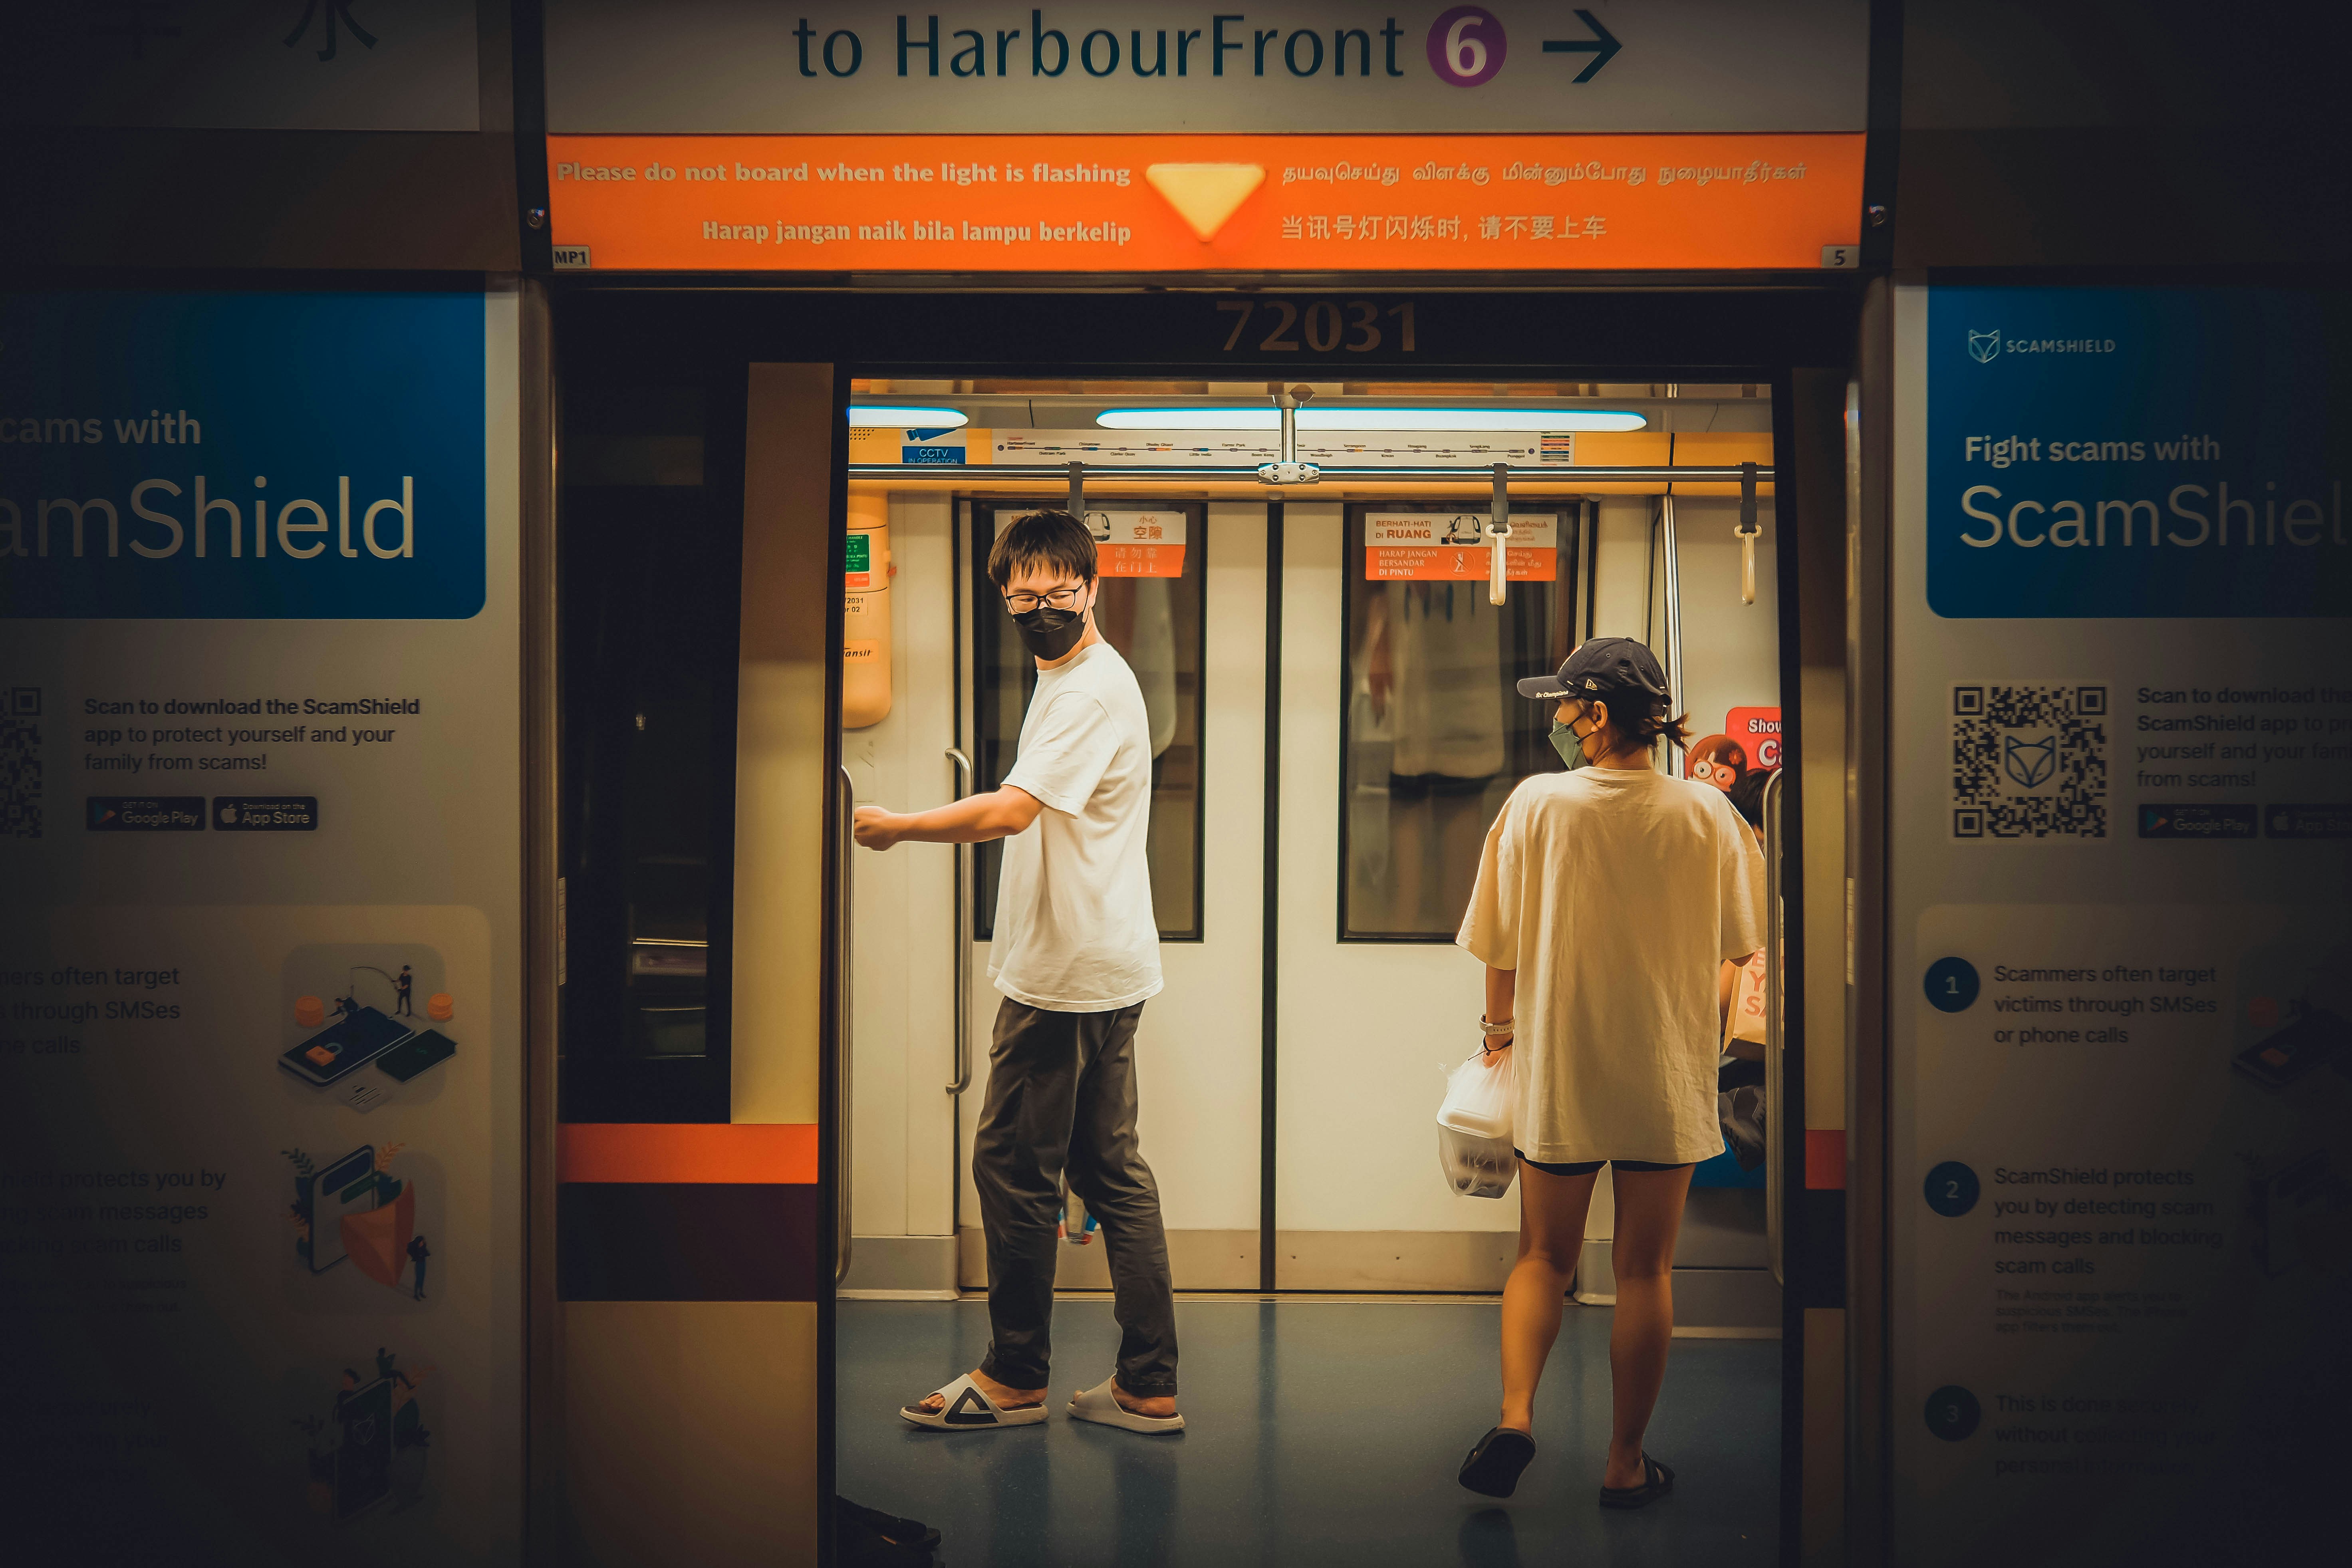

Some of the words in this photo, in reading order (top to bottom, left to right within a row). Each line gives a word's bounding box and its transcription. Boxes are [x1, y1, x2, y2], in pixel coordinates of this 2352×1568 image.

[793, 18, 863, 77] to
[897, 8, 1404, 77] HarbourFront
[1445, 16, 1487, 77] 6
[556, 162, 636, 183] Please
[644, 162, 677, 182] do
[685, 163, 727, 182] not
[735, 162, 809, 183] board
[817, 162, 885, 182] when
[893, 163, 934, 182] the
[941, 162, 997, 186] light
[1006, 162, 1025, 182] is
[1033, 162, 1131, 186] flashing
[1282, 160, 1400, 186] தயவுசெய்து
[1412, 160, 1490, 186] விளக்கு
[703, 221, 769, 246] Harap
[776, 221, 851, 244] jangan
[858, 220, 907, 241] naik
[913, 220, 955, 242] bila
[963, 221, 1032, 245] lampu
[1039, 221, 1131, 246] berkelip
[554, 250, 587, 265] MP1
[1834, 250, 1844, 266] 5
[1215, 300, 1416, 353] 72031
[2007, 339, 2116, 353] SCAMSHIELD
[115, 410, 201, 444] with
[919, 449, 948, 457] CCTV
[1965, 436, 2041, 468] Fight
[2048, 441, 2146, 462] scams
[2154, 435, 2220, 461] with
[1133, 526, 1163, 540] 空隙
[1387, 530, 1431, 539] RUANG
[2138, 687, 2186, 704] Scan
[2192, 689, 2211, 703] to
[2217, 687, 2314, 704] download
[85, 698, 134, 715] Scan
[139, 699, 158, 715] to
[164, 697, 261, 715] download
[266, 698, 299, 715] the
[303, 697, 420, 716] ScamShield
[2138, 715, 2255, 732] ScamShield
[2260, 719, 2296, 736] app
[2304, 717, 2323, 732] to
[85, 727, 122, 744] app
[128, 727, 147, 743] to
[153, 727, 222, 746] protect
[228, 725, 306, 746] yourself
[311, 727, 346, 744] and
[352, 729, 395, 746] your
[85, 752, 141, 774] family
[148, 753, 193, 771] from
[199, 753, 267, 771] scams!
[2138, 744, 2215, 763] yourself
[2221, 745, 2256, 760] and
[2263, 747, 2305, 763] your
[2138, 771, 2182, 788] from
[2187, 771, 2255, 787] scams!
[122, 811, 169, 826] Google
[171, 811, 198, 826] Play
[242, 812, 270, 826] App
[273, 812, 310, 823] Store
[2173, 818, 2221, 834] Google
[2223, 818, 2250, 833] Play
[2295, 818, 2323, 834] App
[51, 967, 108, 986] often
[115, 968, 180, 988] target
[1995, 967, 2096, 982] Scammers
[2102, 965, 2153, 982] often
[2159, 967, 2216, 986] target
[1946, 977, 1959, 994] 1
[12, 1001, 98, 1022] through
[105, 1002, 181, 1020] SMSes
[1995, 997, 2062, 1013] victims
[2068, 996, 2144, 1016] through
[2150, 997, 2216, 1013] SMSes
[32, 1036, 80, 1054] calls
[1995, 1030, 2013, 1043] or
[2019, 1027, 2079, 1047] phone
[2086, 1027, 2128, 1043] calls
[60, 1170, 149, 1189] protects
[156, 1173, 194, 1191] you
[200, 1169, 226, 1191] by
[1995, 1168, 2108, 1185] ScamShield
[2113, 1168, 2193, 1187] protects
[1946, 1181, 1959, 1199] 2
[99, 1205, 208, 1223] messages
[1995, 1201, 2029, 1218] you
[2035, 1199, 2058, 1218] by
[2064, 1198, 2156, 1218] detecting
[2162, 1202, 2213, 1215] scam
[134, 1235, 182, 1253] calls
[1995, 1230, 2092, 1248] messages
[2099, 1229, 2134, 1245] and
[2140, 1229, 2223, 1248] blocking
[1995, 1259, 2046, 1275] scam
[2052, 1258, 2094, 1274] calls
[1947, 1405, 1959, 1422] 3
[1997, 1395, 2035, 1413] This
[2041, 1395, 2056, 1412] is
[2062, 1395, 2111, 1413] done
[1995, 1428, 2067, 1443] without
